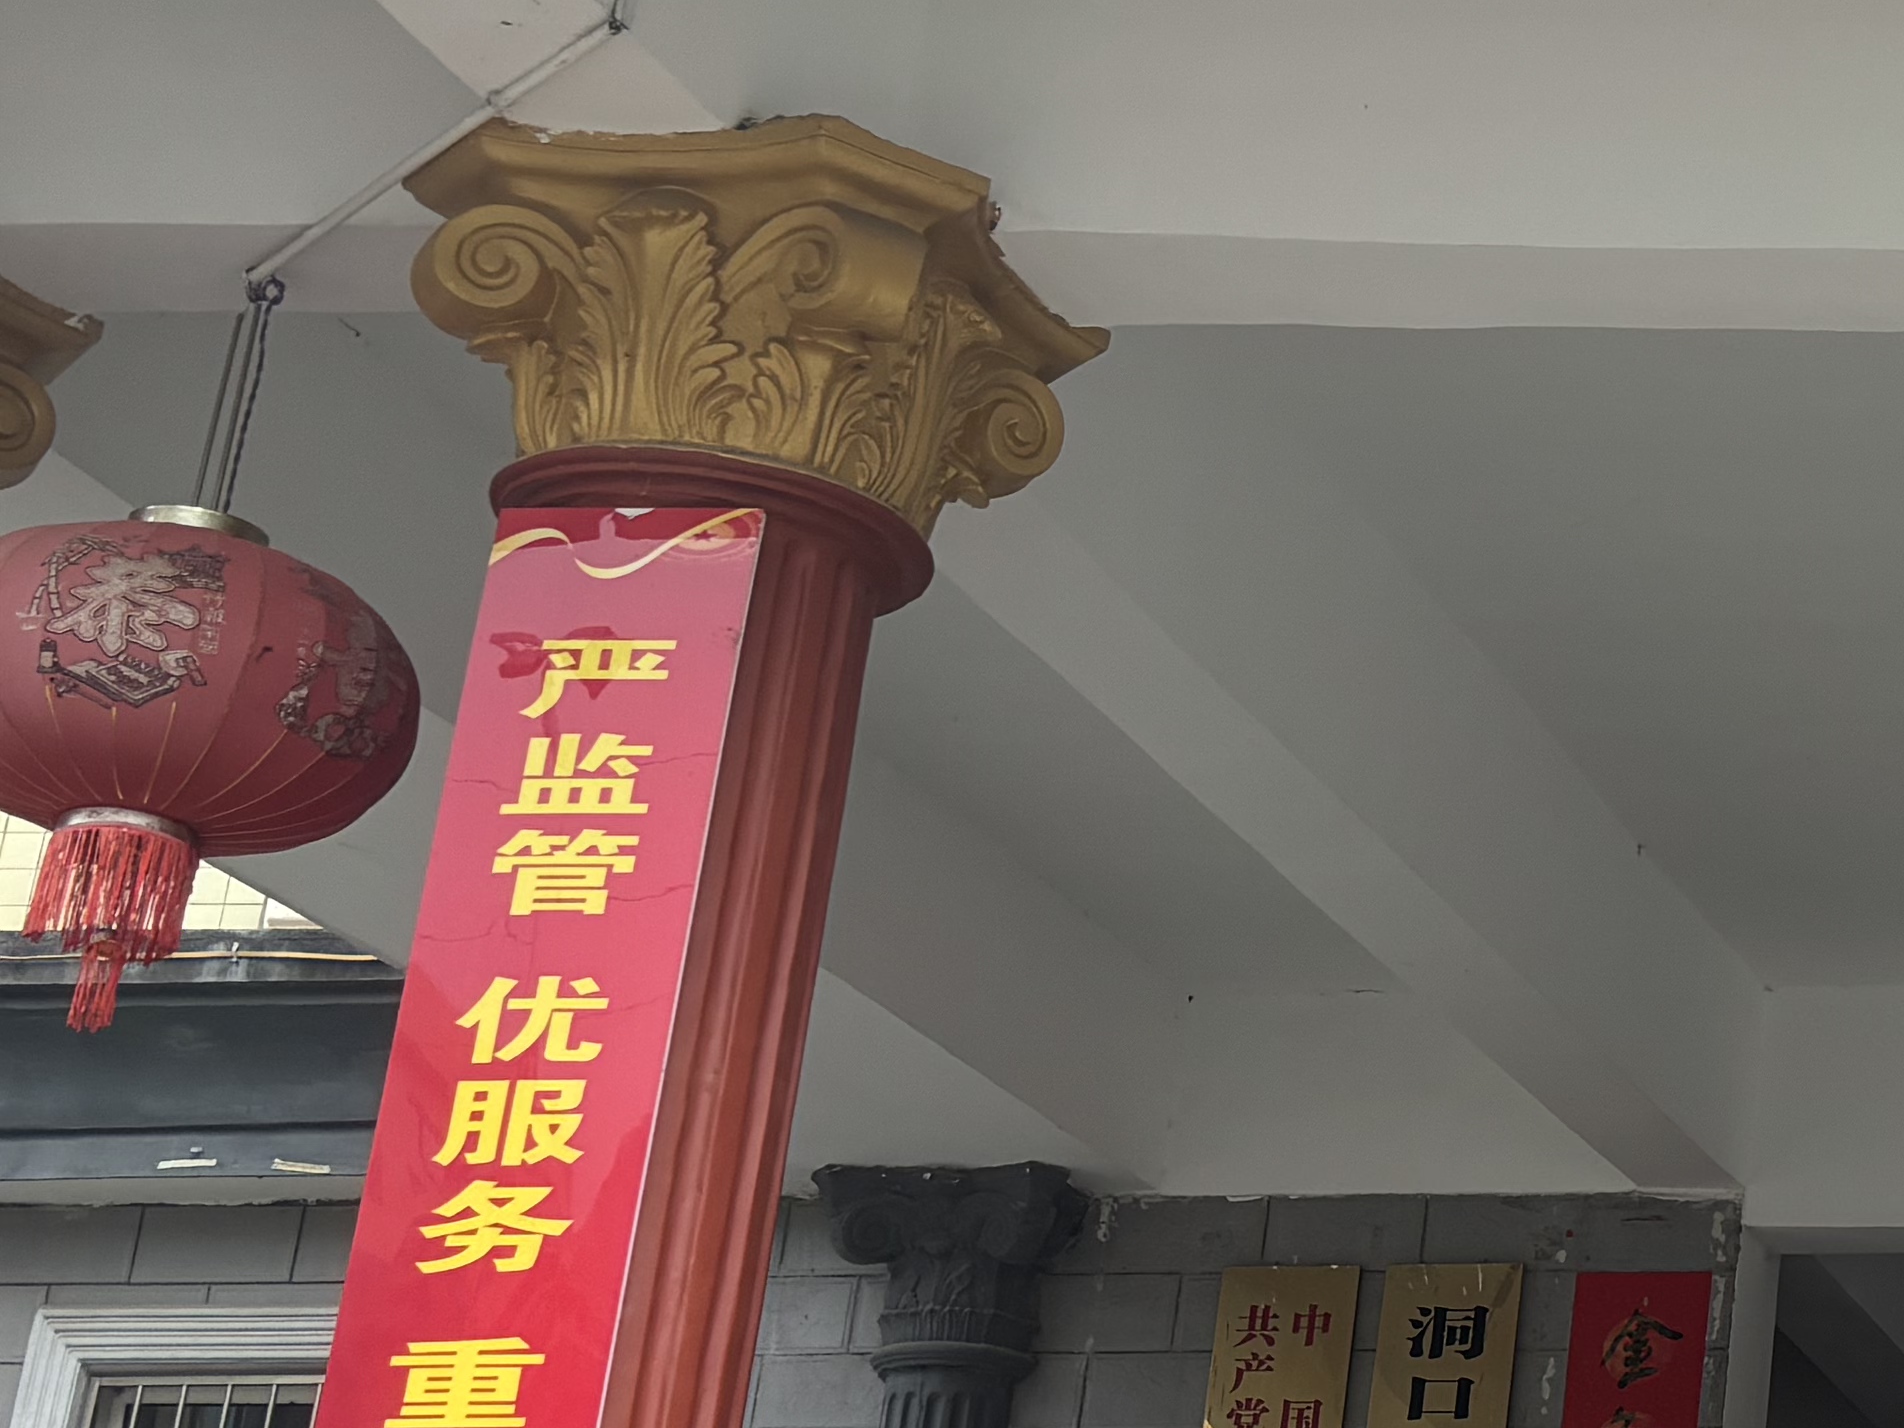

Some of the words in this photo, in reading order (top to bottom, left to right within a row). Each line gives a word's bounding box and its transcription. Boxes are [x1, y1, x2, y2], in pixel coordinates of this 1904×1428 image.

[491, 639, 677, 916] 严监管
[416, 975, 609, 1274] 优服务
